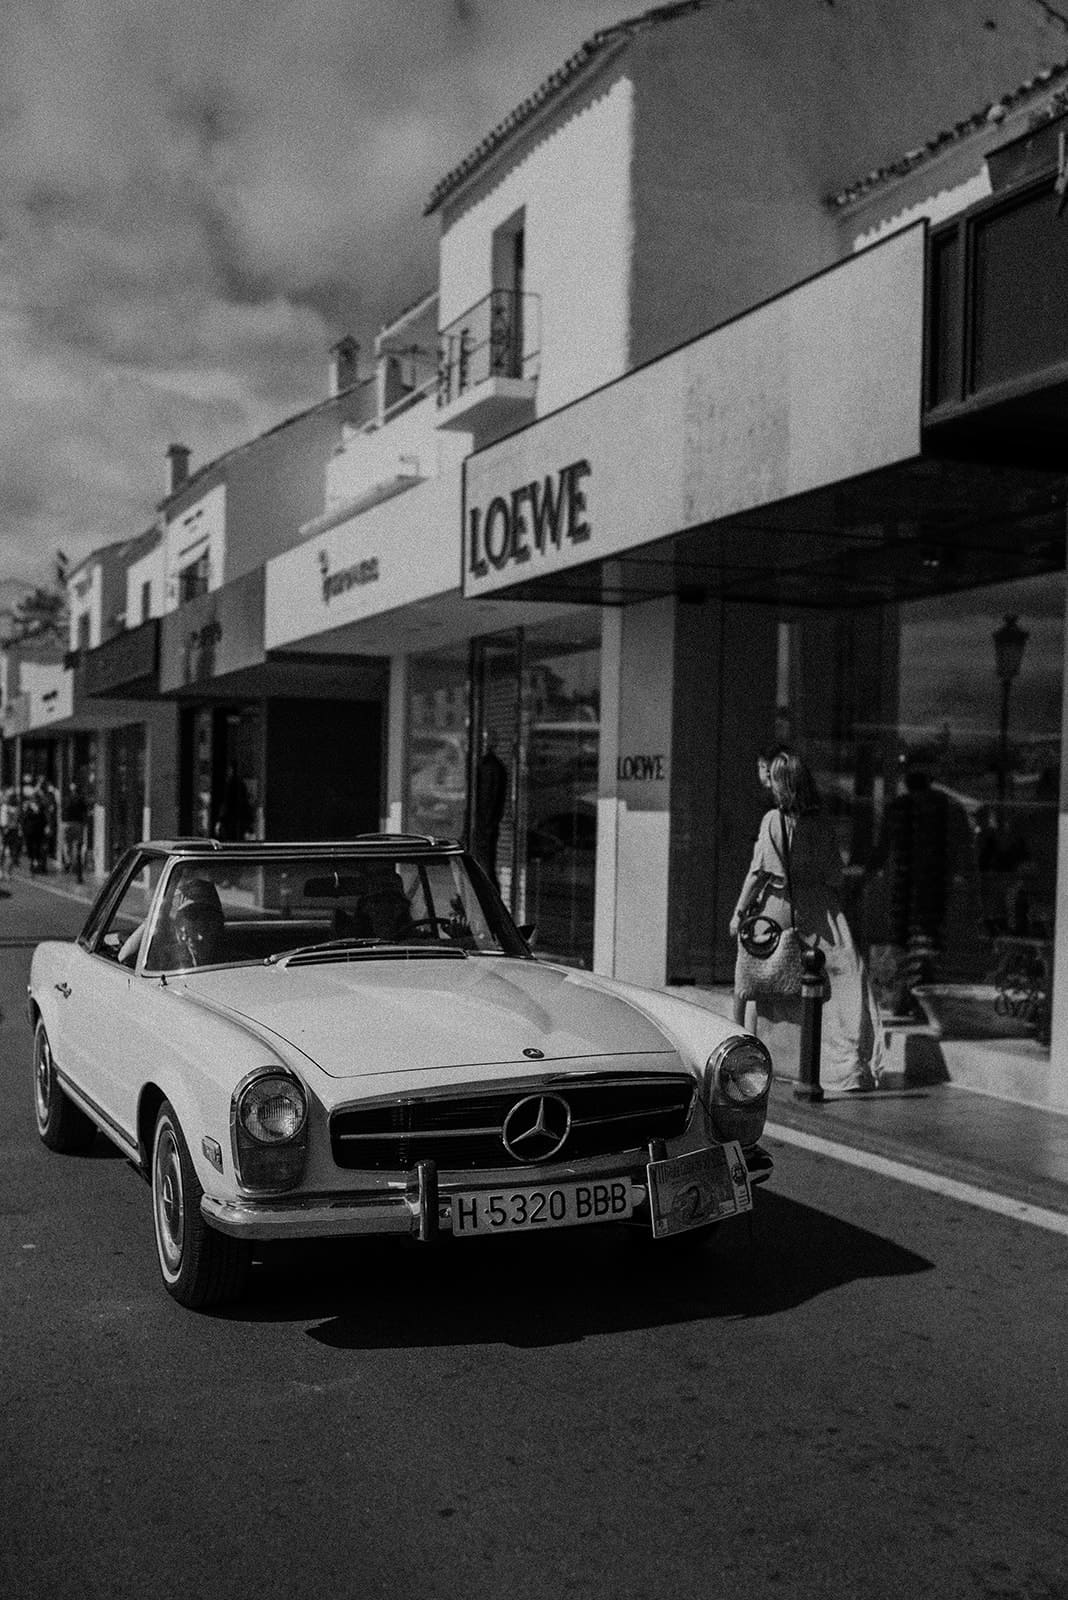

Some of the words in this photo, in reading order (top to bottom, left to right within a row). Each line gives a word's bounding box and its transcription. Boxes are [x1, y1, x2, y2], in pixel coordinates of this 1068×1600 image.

[470, 458, 592, 578] LOEWE
[617, 755, 665, 780] LOEWE
[458, 1198, 477, 1230] H
[489, 1190, 566, 1227] 5320
[576, 1183, 627, 1218] BBB
